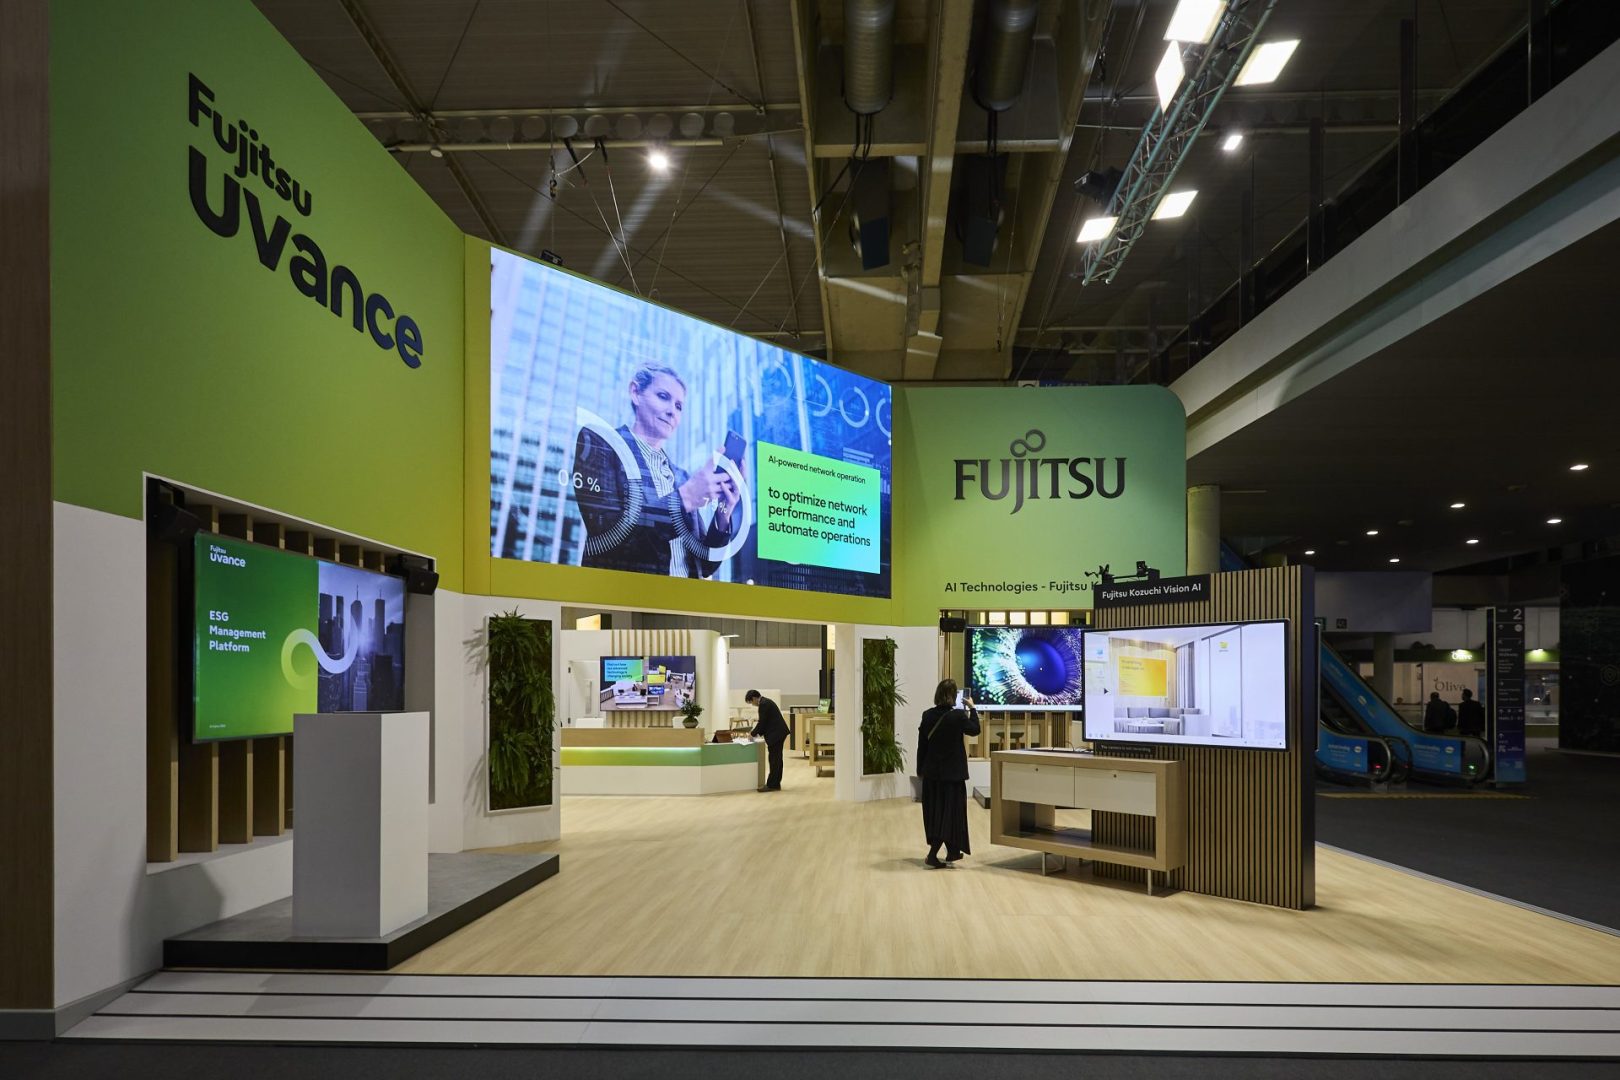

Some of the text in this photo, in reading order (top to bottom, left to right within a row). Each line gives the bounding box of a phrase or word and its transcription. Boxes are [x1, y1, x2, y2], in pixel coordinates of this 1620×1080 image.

[188, 72, 312, 217] Fujitsu
[188, 145, 424, 369] Uvance
[768, 455, 866, 484] AI-powered network operation
[953, 455, 1127, 515] FUJITSU
[768, 486, 868, 516] to optimize network
[768, 505, 855, 528] performance and
[768, 521, 871, 547] automate operations
[209, 545, 227, 554] Fujitsu
[944, 581, 957, 593] AI
[960, 581, 1039, 596] Technologies
[1049, 581, 1087, 595] Fujitsu
[1102, 583, 1202, 601] Fujitsu Kozuchi Vision AI
[209, 610, 229, 622] ESG
[1512, 608, 1523, 620] 2
[209, 625, 266, 640] Management
[209, 640, 250, 653] Platform
[1434, 680, 1466, 692] Olive
